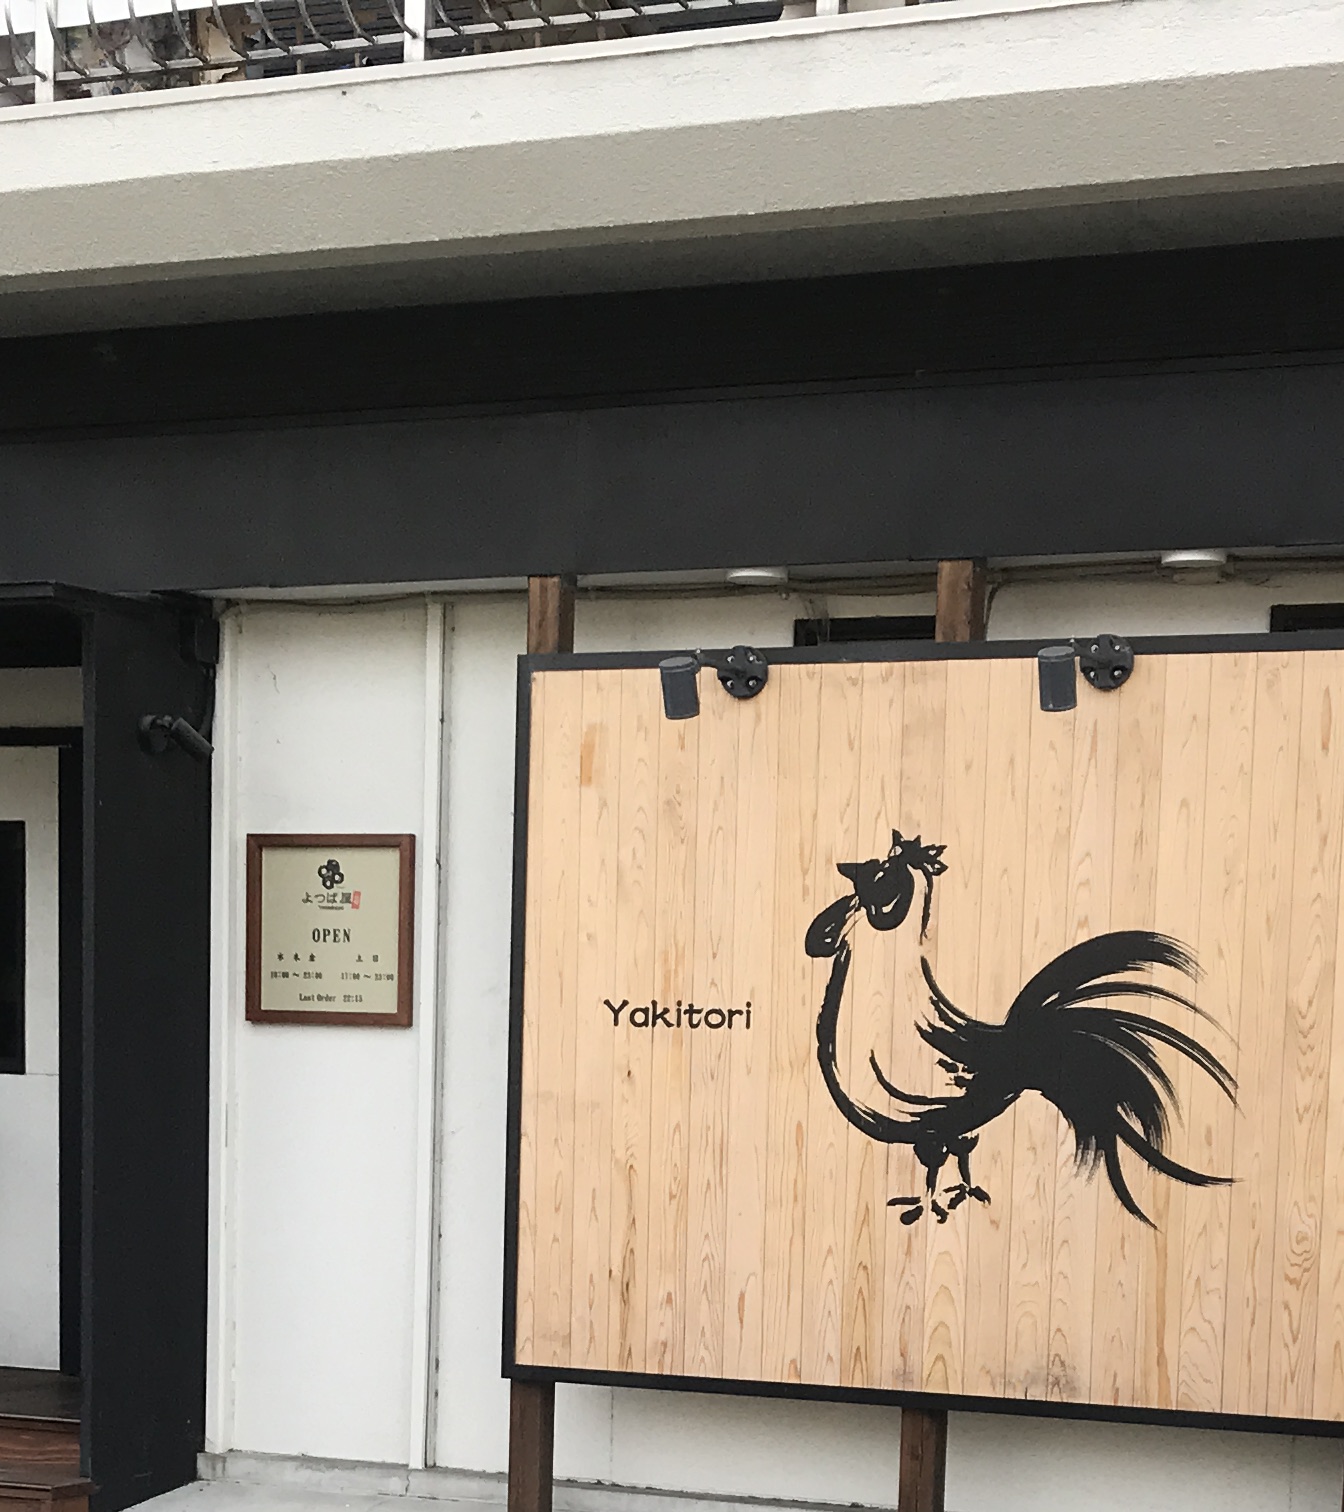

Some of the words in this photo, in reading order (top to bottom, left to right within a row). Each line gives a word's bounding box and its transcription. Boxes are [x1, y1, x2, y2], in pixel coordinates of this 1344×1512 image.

[312, 927, 351, 943] OPEN
[298, 993, 315, 1002] Last
[316, 993, 336, 1003] Order
[603, 999, 752, 1030] Yakitori
